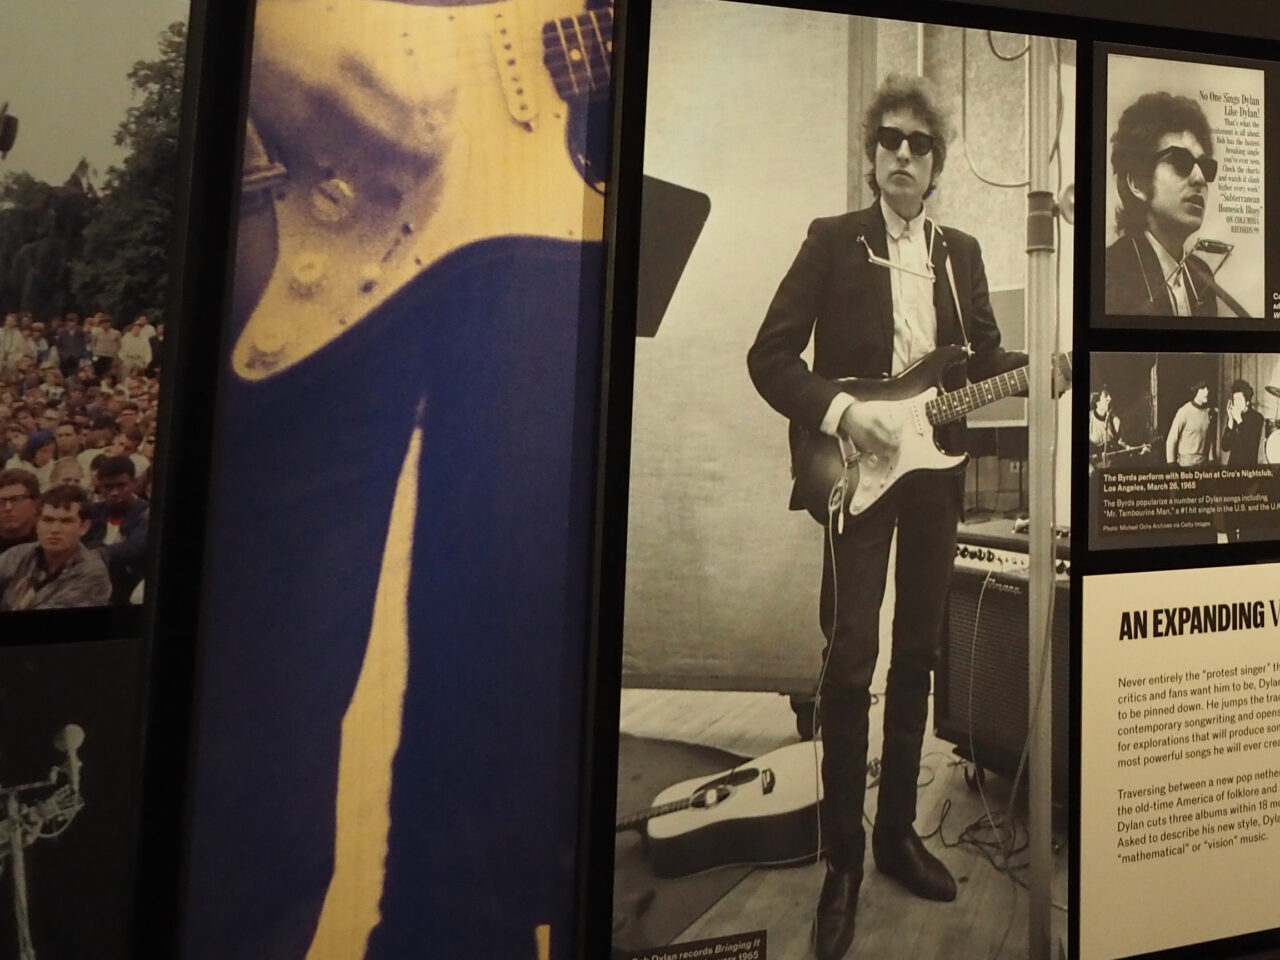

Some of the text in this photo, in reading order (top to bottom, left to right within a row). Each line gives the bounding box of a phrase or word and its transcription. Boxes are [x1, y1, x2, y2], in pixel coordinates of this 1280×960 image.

[1200, 90, 1260, 107] No One Sings Dylan
[1225, 105, 1260, 119] Like Dylan!
[1103, 481, 1195, 492] Los Angeles, March 26, 1965
[1117, 473, 1136, 482] Byrds
[1138, 472, 1163, 481] perform
[1180, 471, 1193, 479] Bob
[1194, 471, 1212, 479] Dylan
[1241, 469, 1273, 478] Nightclub,
[1118, 610, 1147, 640] AN
[1152, 600, 1264, 637] EXPANDING
[1118, 677, 1146, 688] Never
[1148, 672, 1182, 685] entirely
[1185, 670, 1199, 681] the
[1202, 666, 1237, 681] "protest
[1240, 662, 1270, 676] singer"
[1117, 691, 1147, 704] critics
[1149, 688, 1166, 701] and
[1168, 687, 1187, 698] fans
[1190, 684, 1211, 695] want
[1213, 682, 1230, 693] him
[1232, 682, 1241, 691] to
[1243, 680, 1256, 690] be,
[1117, 721, 1182, 736] contemporary
[1184, 713, 1236, 728] songwriting
[1237, 709, 1253, 721] and
[1255, 708, 1280, 720] opens
[1117, 740, 1131, 754] for
[1132, 734, 1189, 750] explorations
[1191, 731, 1209, 742] that
[1211, 728, 1226, 739] will
[1229, 725, 1264, 740] produce
[1117, 755, 1141, 768] most
[1142, 749, 1182, 766] powerful
[1185, 746, 1211, 759] songs
[1213, 744, 1224, 755] he
[1226, 741, 1241, 753] will
[1243, 741, 1261, 751] ever
[1117, 784, 1166, 800] Traversing
[1168, 780, 1206, 793] between
[1208, 779, 1213, 787] a
[1216, 776, 1233, 786] new
[1236, 773, 1252, 784] pop
[1117, 804, 1132, 816] the
[1134, 799, 1173, 815] old-time
[1175, 793, 1213, 807] America
[1215, 790, 1224, 801] of
[1226, 787, 1259, 799] folklore
[1261, 782, 1277, 794] and
[1117, 819, 1144, 834] Dylan
[1146, 815, 1167, 828] cuts
[1168, 813, 1193, 824] three
[1195, 807, 1227, 820] albums
[1229, 801, 1256, 815] within
[1258, 799, 1267, 810] 18
[1117, 831, 1268, 863] "mathematical" or "vision" music.
[680, 947, 713, 958] records
[714, 940, 752, 954] Bringing
